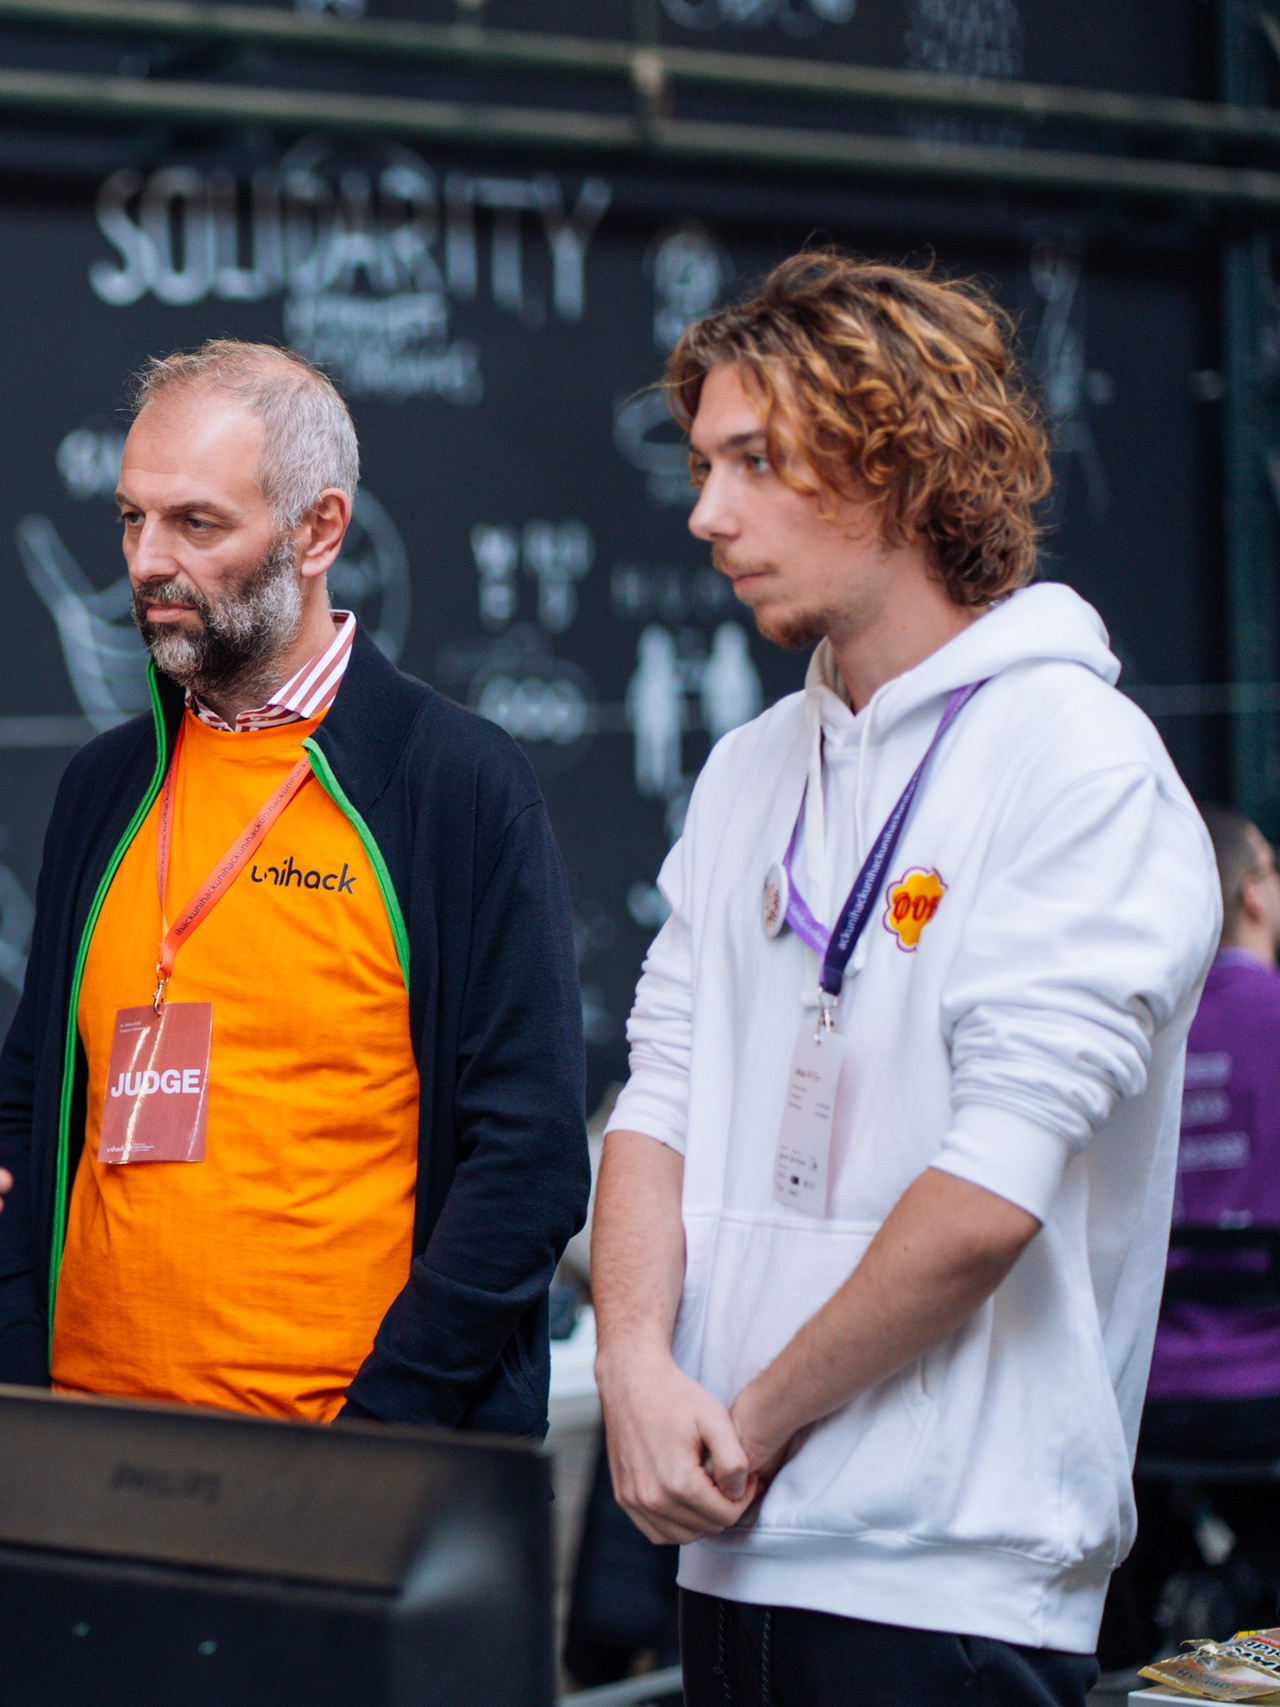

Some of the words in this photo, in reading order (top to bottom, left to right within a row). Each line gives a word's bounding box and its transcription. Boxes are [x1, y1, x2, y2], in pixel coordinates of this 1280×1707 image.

[88, 164, 613, 320] SOLIDARITY
[250, 855, 358, 895] unihack
[110, 1068, 202, 1098] JUDGE
